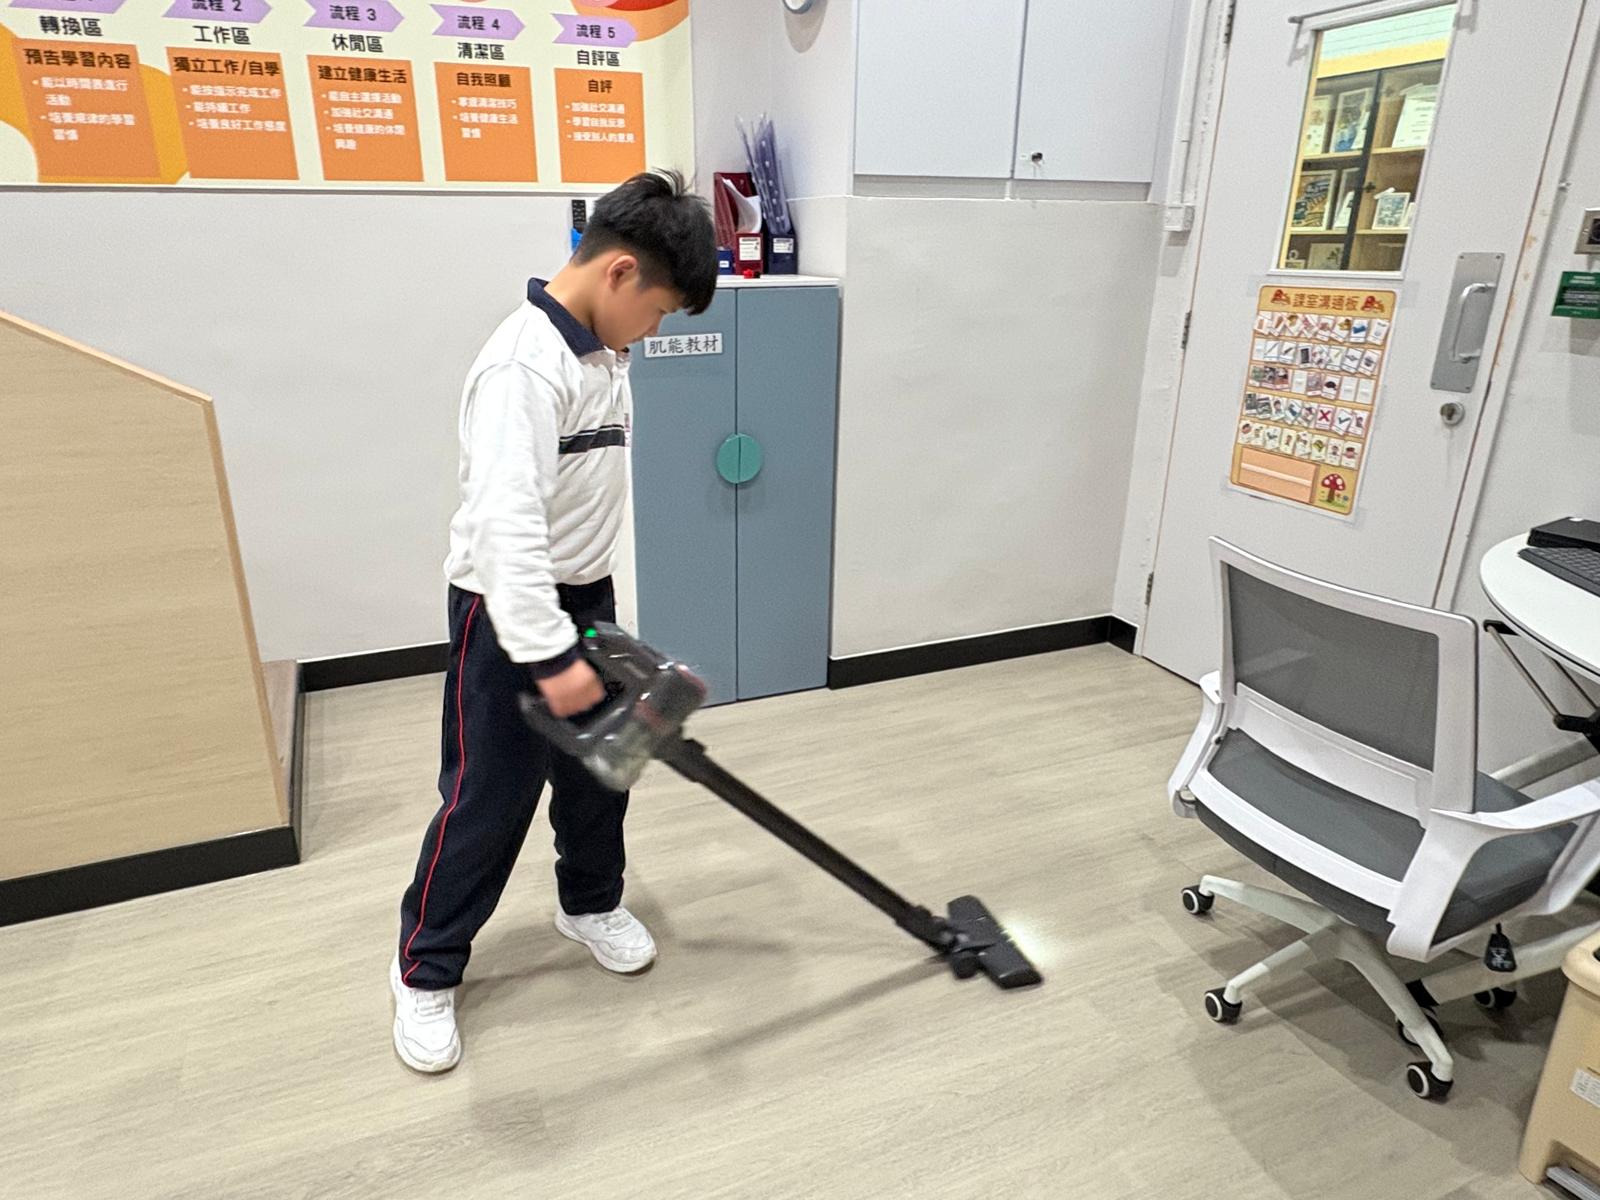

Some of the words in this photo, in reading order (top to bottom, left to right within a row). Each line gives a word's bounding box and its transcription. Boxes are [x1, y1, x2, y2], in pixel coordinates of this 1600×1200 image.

[233, 0, 243, 12] 2
[329, 4, 361, 21] 流程
[367, 8, 377, 21] 3
[39, 15, 104, 37] 轉換區
[457, 15, 486, 31] 流程
[491, 18, 501, 31] 4
[576, 23, 602, 39] 流程
[607, 26, 616, 39] 5
[192, 25, 252, 45] 工作區
[331, 33, 384, 53] 休閒區
[23, 48, 131, 69] 預告學習內容
[457, 42, 505, 61] 清潔區
[577, 49, 620, 67] 自評區
[173, 56, 281, 77] 獨立工作/自學
[317, 65, 408, 84] 建立健康生活
[456, 71, 512, 88] 自我照顧
[588, 79, 613, 94] 自評
[649, 335, 718, 354] 肌能教材
